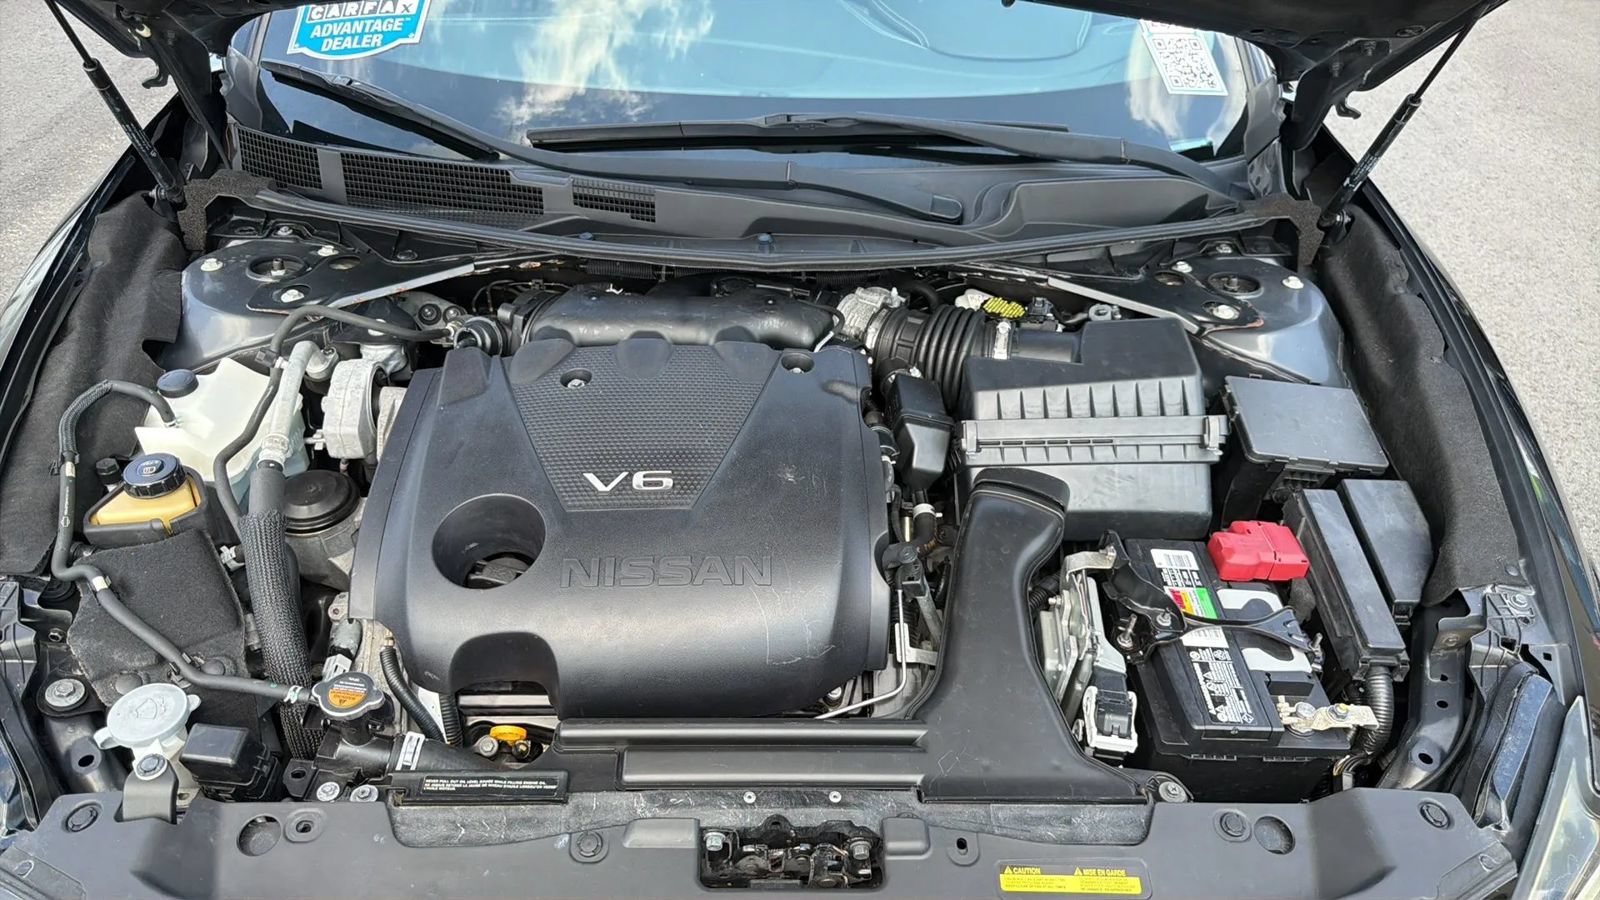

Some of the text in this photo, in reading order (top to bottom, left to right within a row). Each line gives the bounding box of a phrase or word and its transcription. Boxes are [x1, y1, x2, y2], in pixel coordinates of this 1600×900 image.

[310, 1, 413, 20] CARFAX
[321, 34, 384, 51] DEALER
[582, 470, 674, 492] V6
[560, 555, 772, 588] NISSAN
[1012, 866, 1041, 875] CAUTION
[1082, 868, 1097, 876] MISE
[1106, 868, 1126, 877] GARDE
